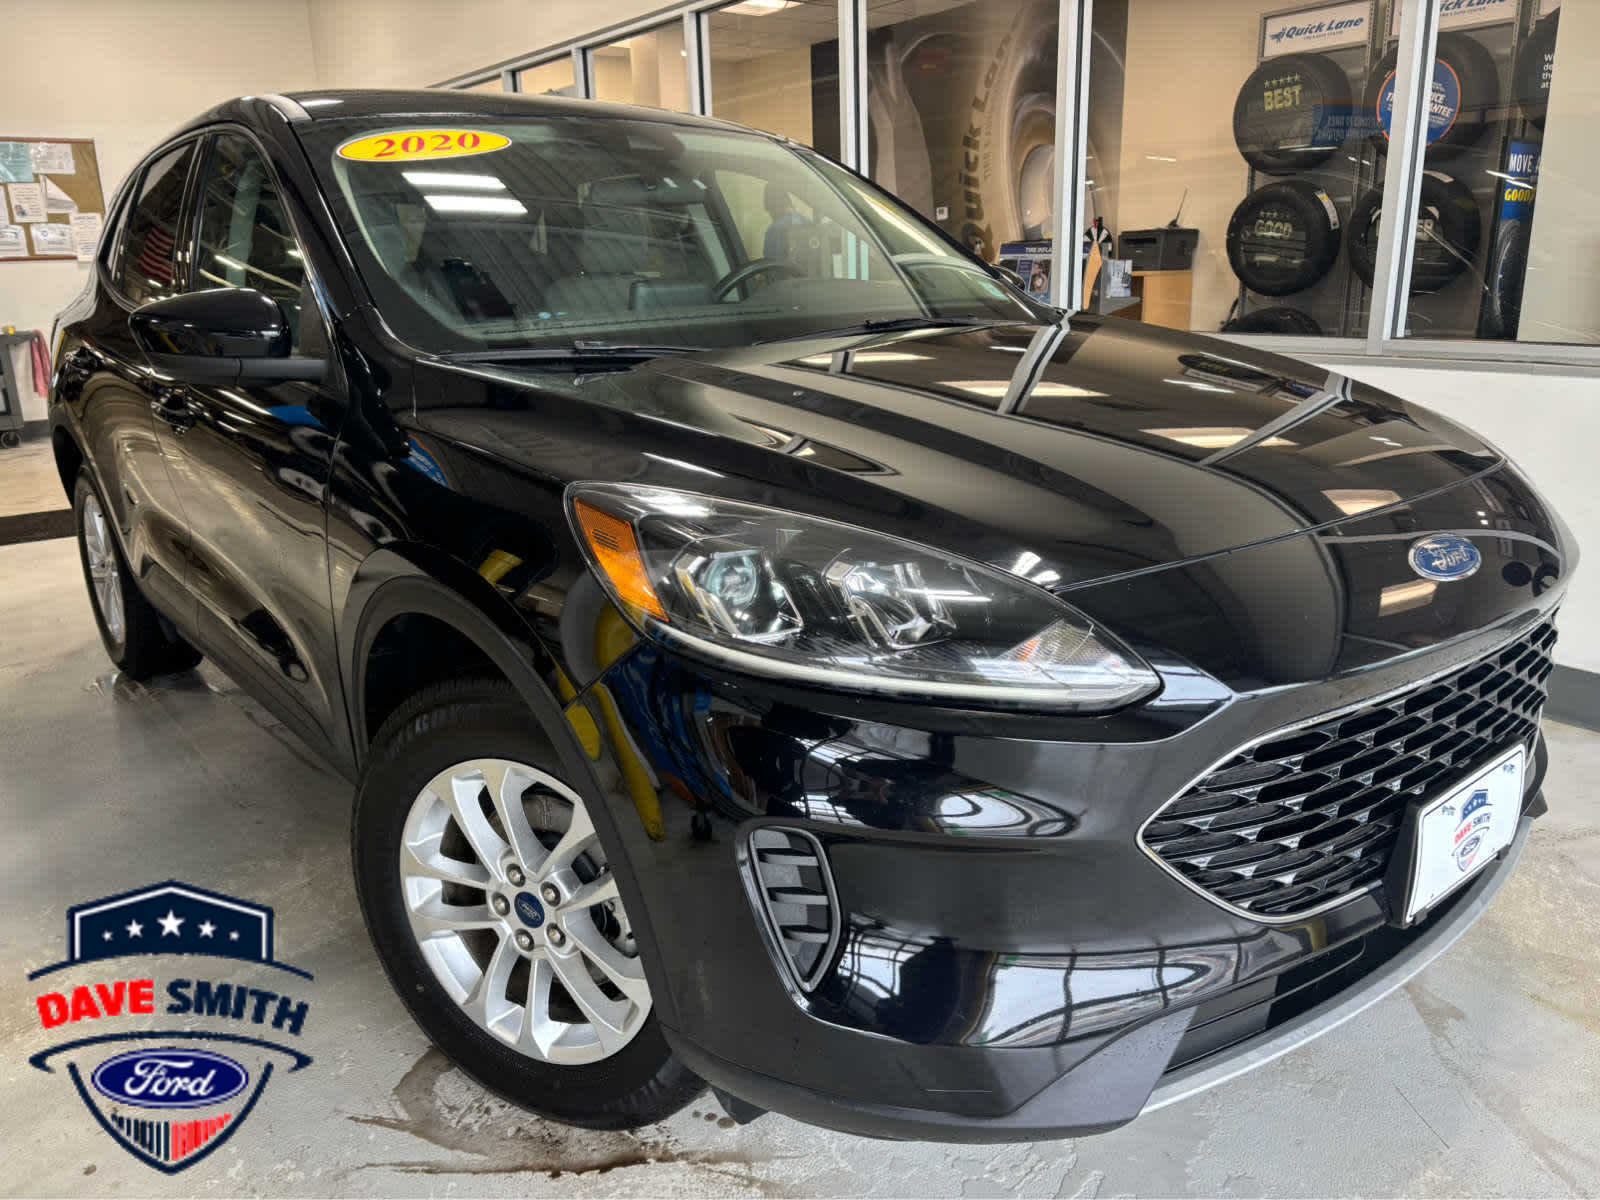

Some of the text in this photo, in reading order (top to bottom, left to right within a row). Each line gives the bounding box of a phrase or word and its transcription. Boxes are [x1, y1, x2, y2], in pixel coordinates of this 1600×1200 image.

[1285, 22, 1325, 38] Quick
[1327, 17, 1364, 31] Lane
[1264, 84, 1302, 112] BEST
[374, 133, 480, 157] 2020
[1509, 153, 1533, 172] MOVE
[1504, 187, 1536, 202] GOOD
[1255, 219, 1293, 239] GOOD
[1423, 543, 1470, 571] Ford
